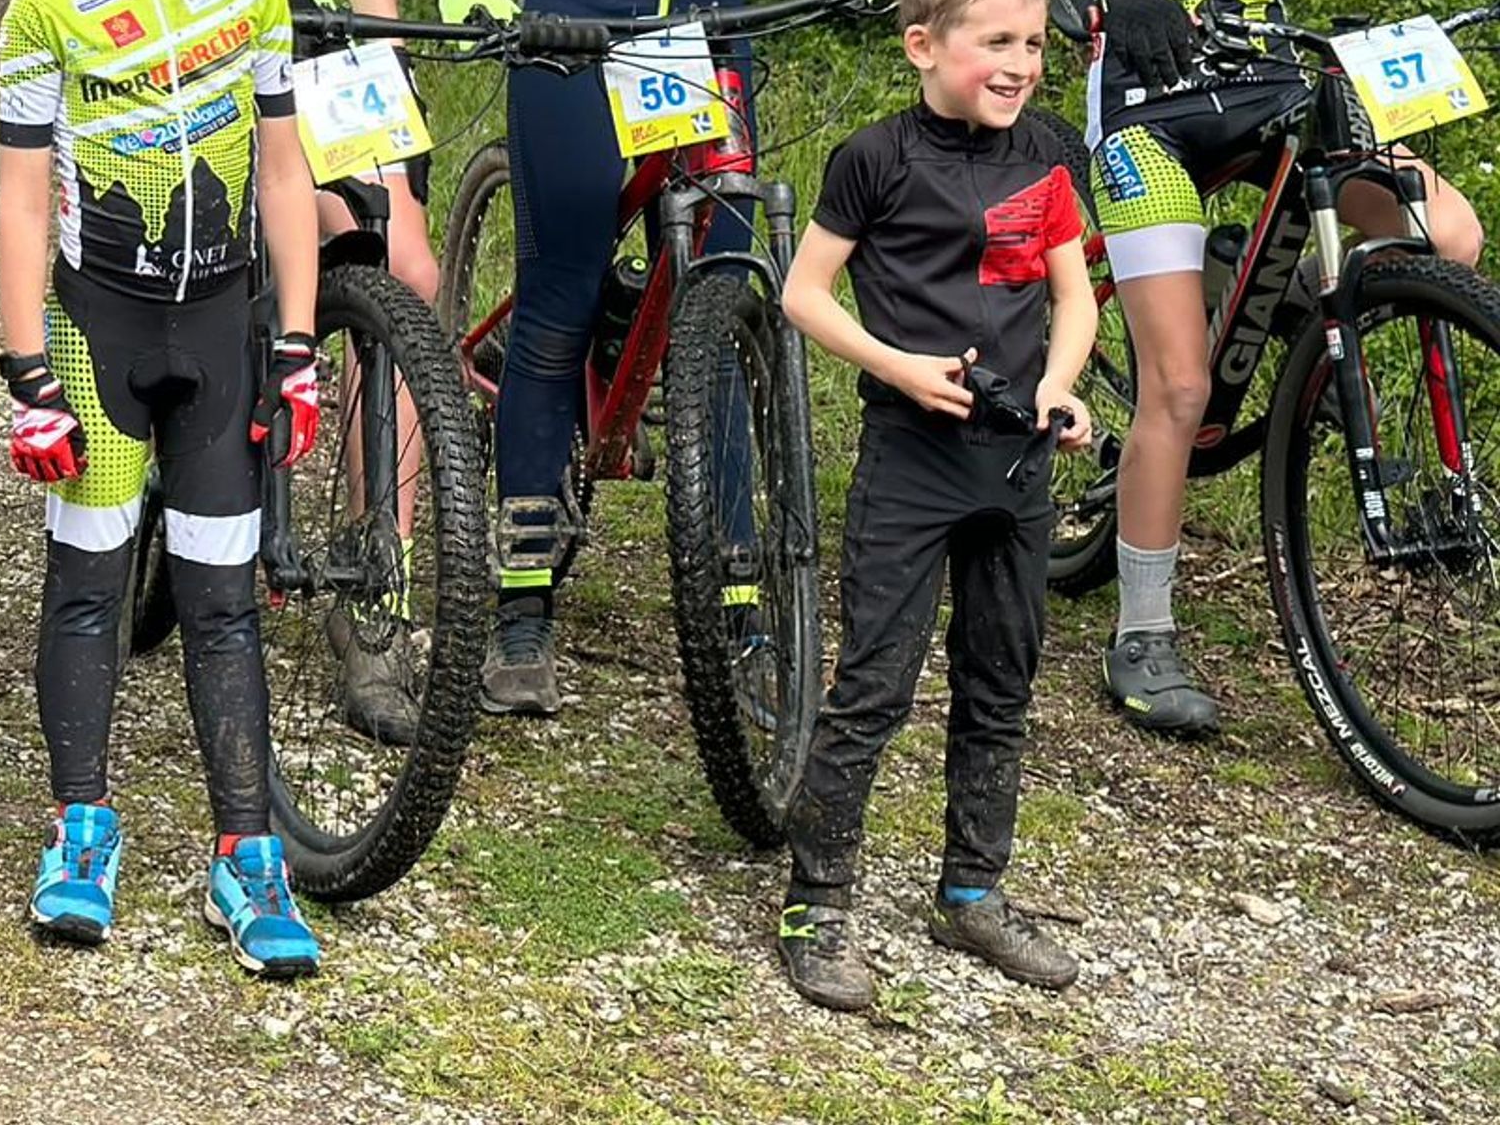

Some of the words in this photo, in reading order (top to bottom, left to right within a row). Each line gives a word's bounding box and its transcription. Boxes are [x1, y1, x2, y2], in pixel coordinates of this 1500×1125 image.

[640, 72, 687, 112] 56
[1380, 52, 1426, 90] 57
[1218, 209, 1310, 386] GIANT
[1296, 636, 1352, 742] MEZCAL
